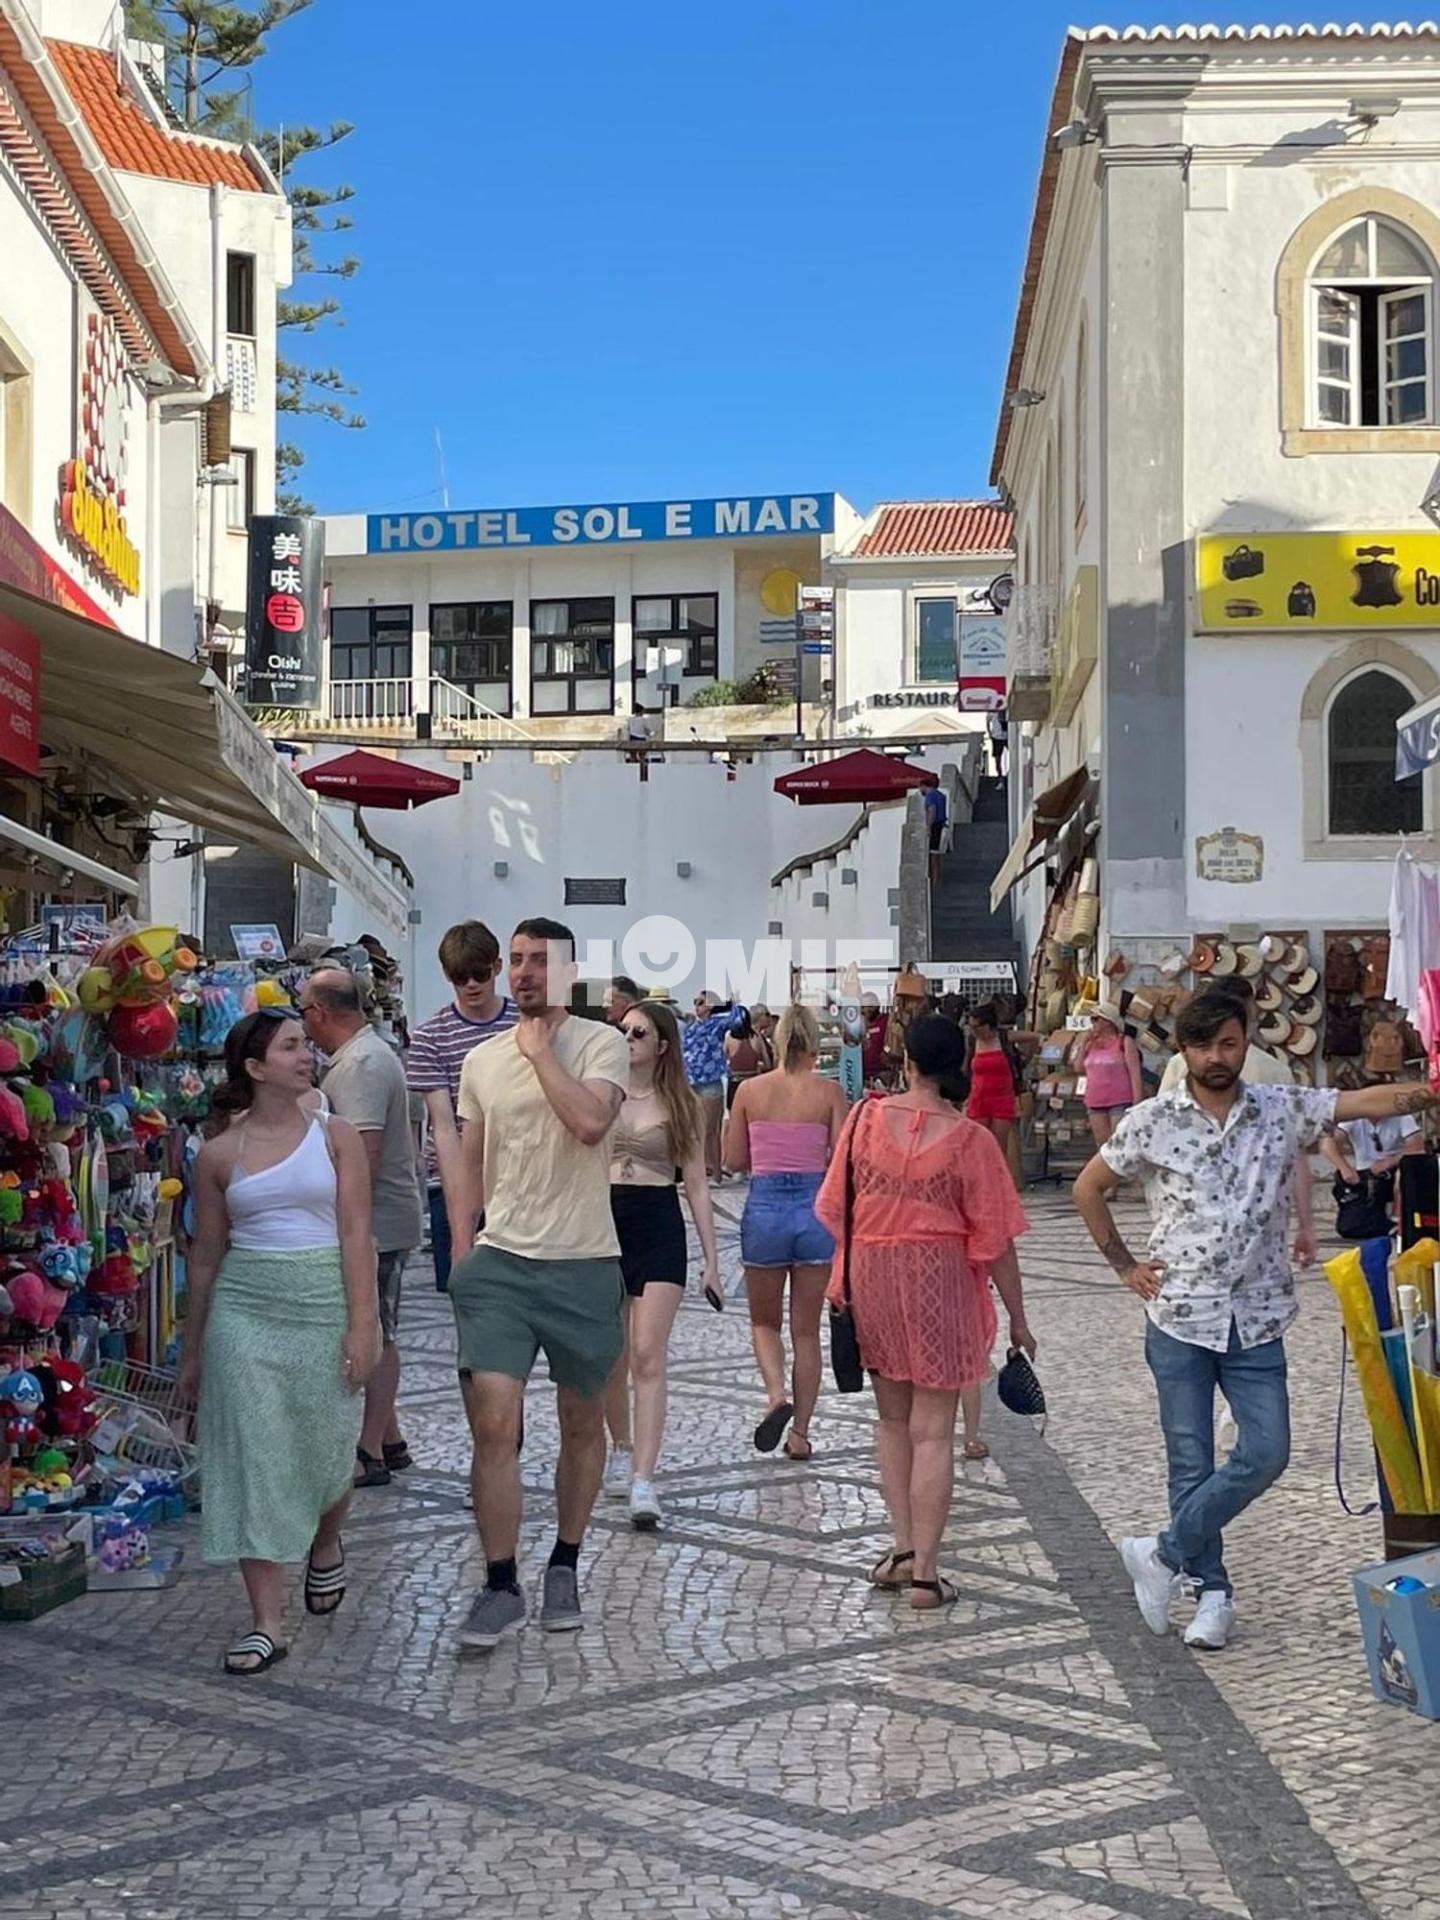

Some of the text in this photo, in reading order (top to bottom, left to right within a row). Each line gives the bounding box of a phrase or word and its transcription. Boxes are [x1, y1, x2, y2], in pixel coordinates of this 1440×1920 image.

[380, 497, 821, 549] HOTEL SOL E MAR
